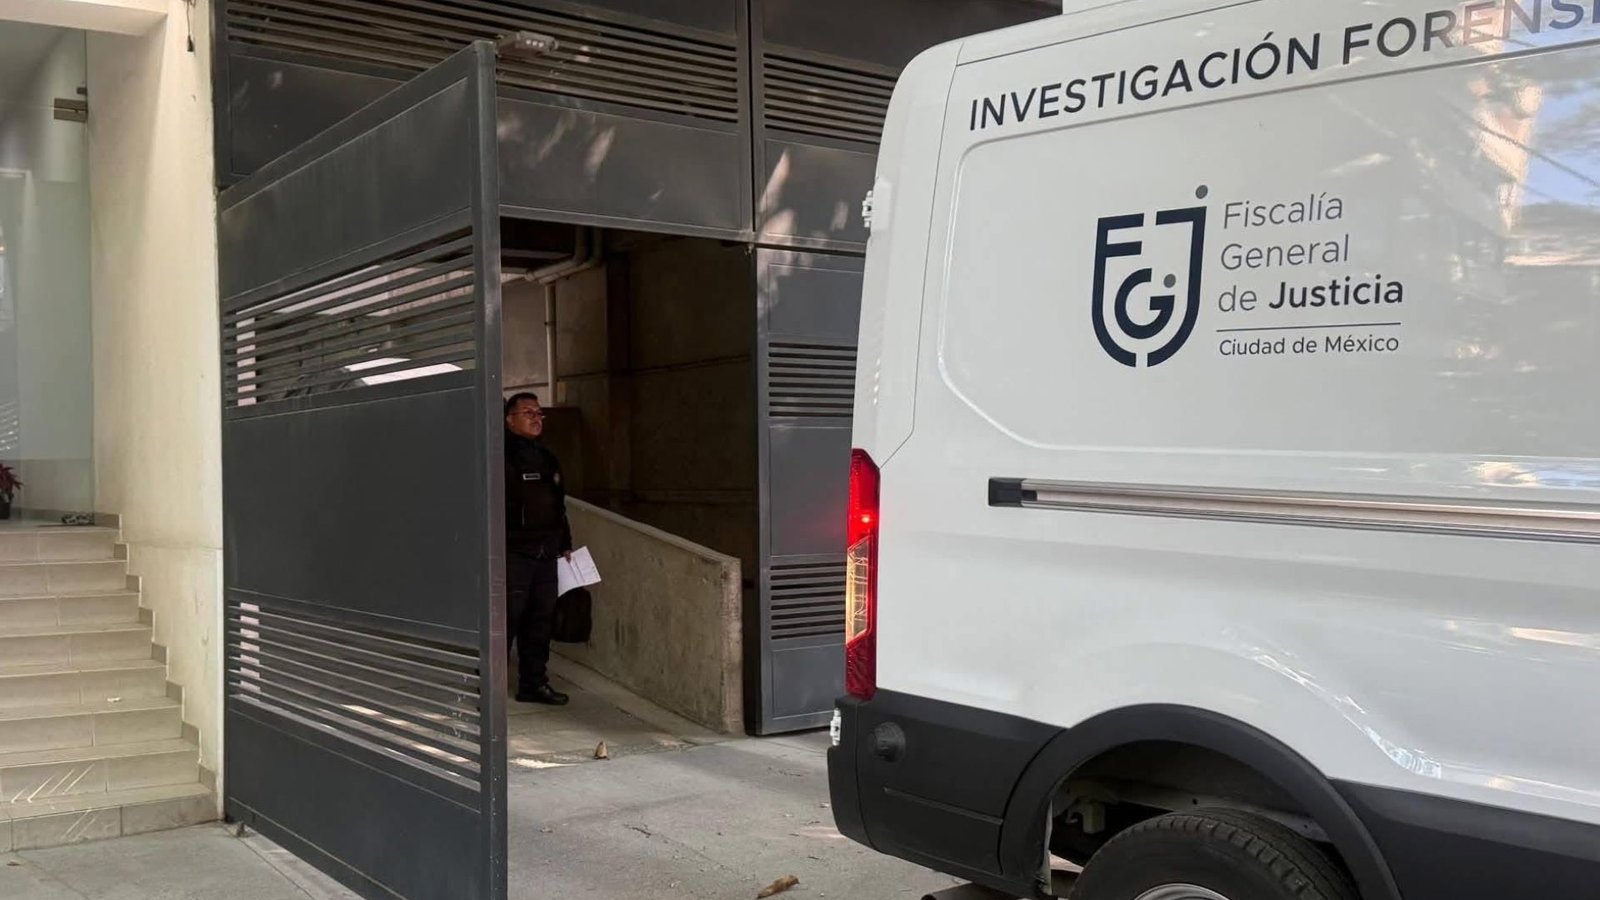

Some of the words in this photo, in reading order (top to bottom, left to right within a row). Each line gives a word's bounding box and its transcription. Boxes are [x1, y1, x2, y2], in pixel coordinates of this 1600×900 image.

[969, 31, 1321, 131] INVESTIGACIÓN
[1341, 0, 1600, 65] FORENS
[1223, 191, 1343, 230] Fiscalía
[1220, 233, 1350, 271] General
[1217, 285, 1258, 312] de
[1268, 274, 1404, 310] Justicia
[1219, 337, 1286, 356] Ciudad
[1292, 337, 1318, 354] de
[1324, 334, 1399, 353] México
